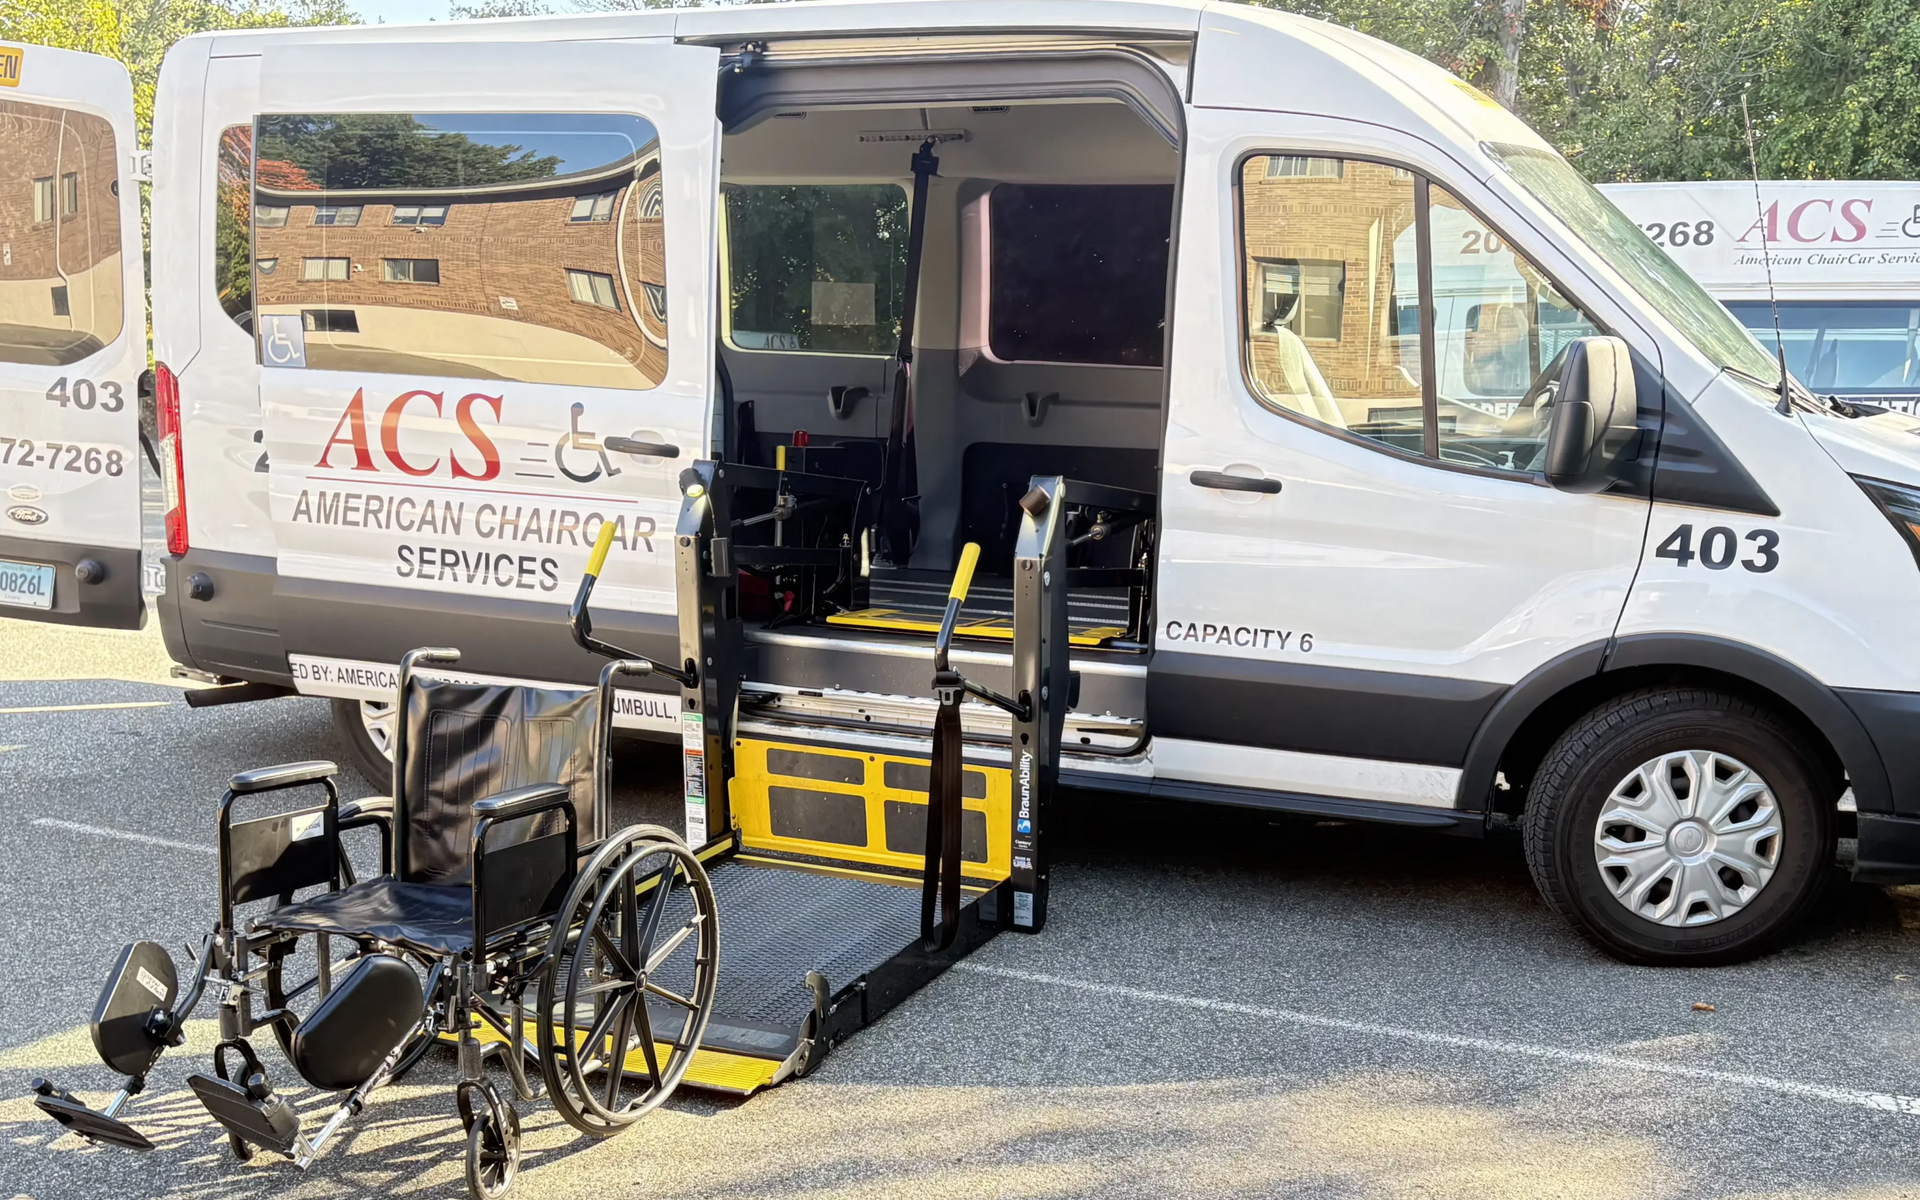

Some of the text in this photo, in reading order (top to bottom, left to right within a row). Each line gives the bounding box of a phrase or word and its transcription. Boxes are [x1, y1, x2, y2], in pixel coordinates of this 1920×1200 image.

[1637, 220, 1714, 248] 268
[1736, 198, 1873, 243] ACS
[1460, 230, 1513, 254] 20
[1734, 253, 1802, 266] American
[1807, 253, 1875, 266] ChairCar
[46, 377, 124, 412] 403
[314, 387, 504, 482] ACS
[0, 437, 123, 477] 72-7268
[292, 489, 657, 553] AMERICAN CHAIRCAR
[1655, 523, 1780, 573] 403
[0, 571, 45, 596] 0826L
[396, 544, 559, 592] SERVICES
[1166, 620, 1314, 652] CAPACITY 6
[312, 665, 334, 682] BY:
[337, 667, 400, 689] AMERICA
[1019, 749, 1033, 818] BraunAbility
